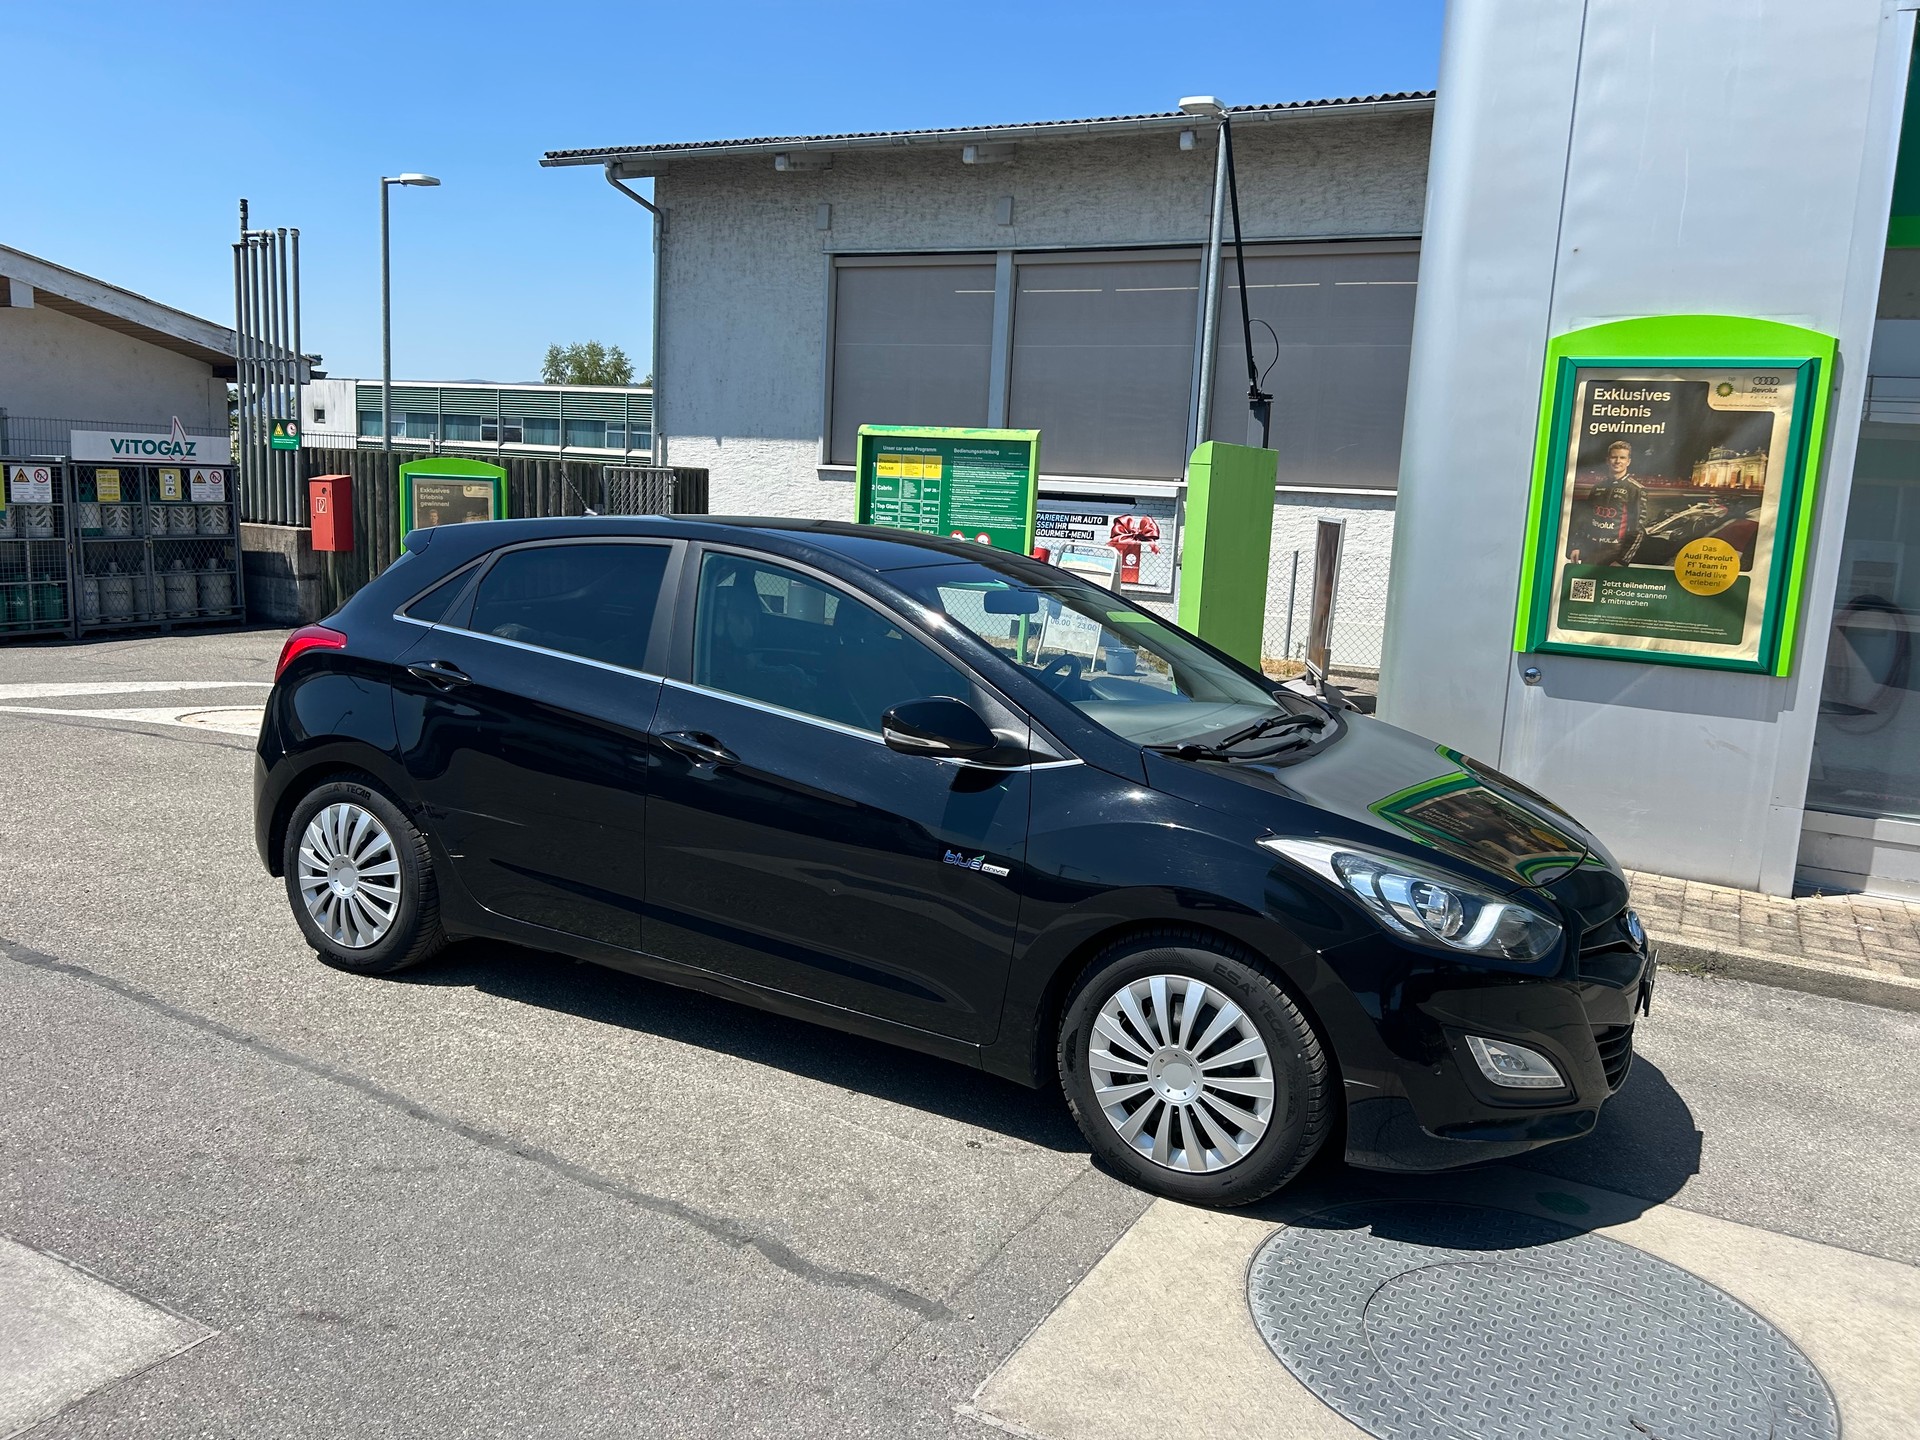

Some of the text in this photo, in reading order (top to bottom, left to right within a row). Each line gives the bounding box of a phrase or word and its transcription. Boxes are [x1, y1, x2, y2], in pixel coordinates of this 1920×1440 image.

[1594, 388, 1671, 401] Exklusives
[1592, 404, 1652, 417] Erlebnis
[1589, 421, 1665, 435] gewinnen!
[1622, 582, 1666, 591] teilnehmen!
[1602, 589, 1635, 598] QR-Code
[1608, 598, 1648, 607] mitmachen
[1077, 622, 1097, 631] 23.00
[943, 849, 1007, 876] blue drive
